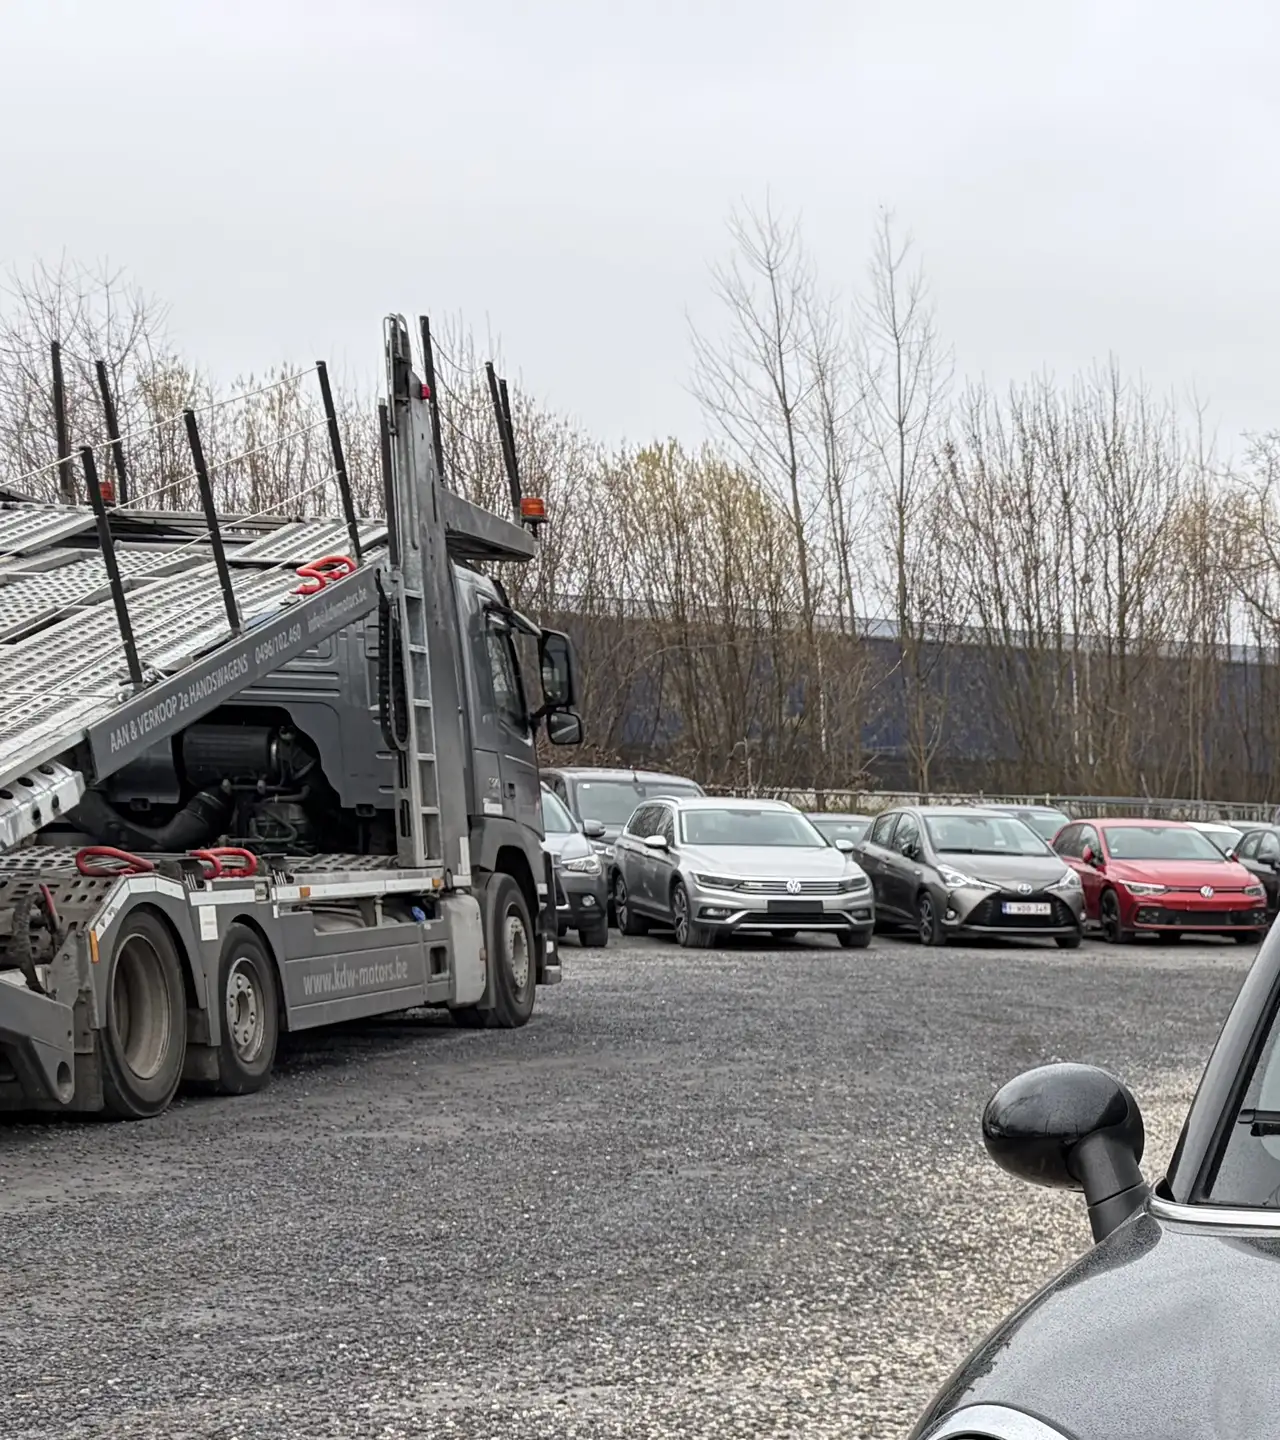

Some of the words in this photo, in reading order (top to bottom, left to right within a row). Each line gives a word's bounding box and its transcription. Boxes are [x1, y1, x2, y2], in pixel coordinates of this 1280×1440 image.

[110, 723, 130, 753] AAN
[130, 719, 138, 741] &
[137, 695, 178, 736] VERKOOP
[188, 653, 249, 704] HANDSWAGENS
[303, 955, 408, 996] www.kdw-motors.be
